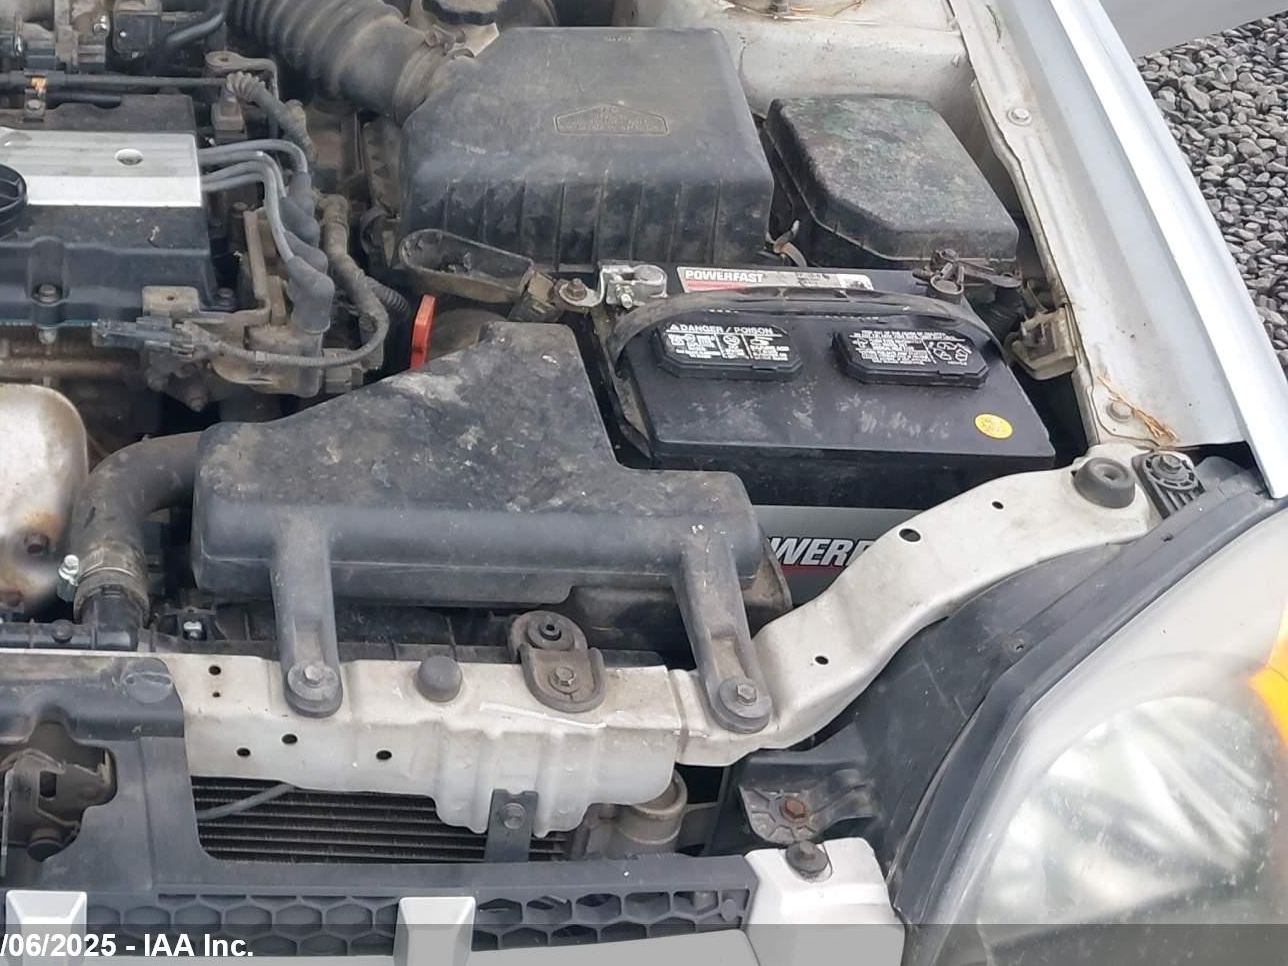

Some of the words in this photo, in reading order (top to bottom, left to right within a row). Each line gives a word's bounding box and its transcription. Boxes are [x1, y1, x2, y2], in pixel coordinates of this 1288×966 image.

[684, 269, 764, 283] POWERFAST
[679, 323, 723, 333] DANGER
[734, 326, 773, 335] POISON
